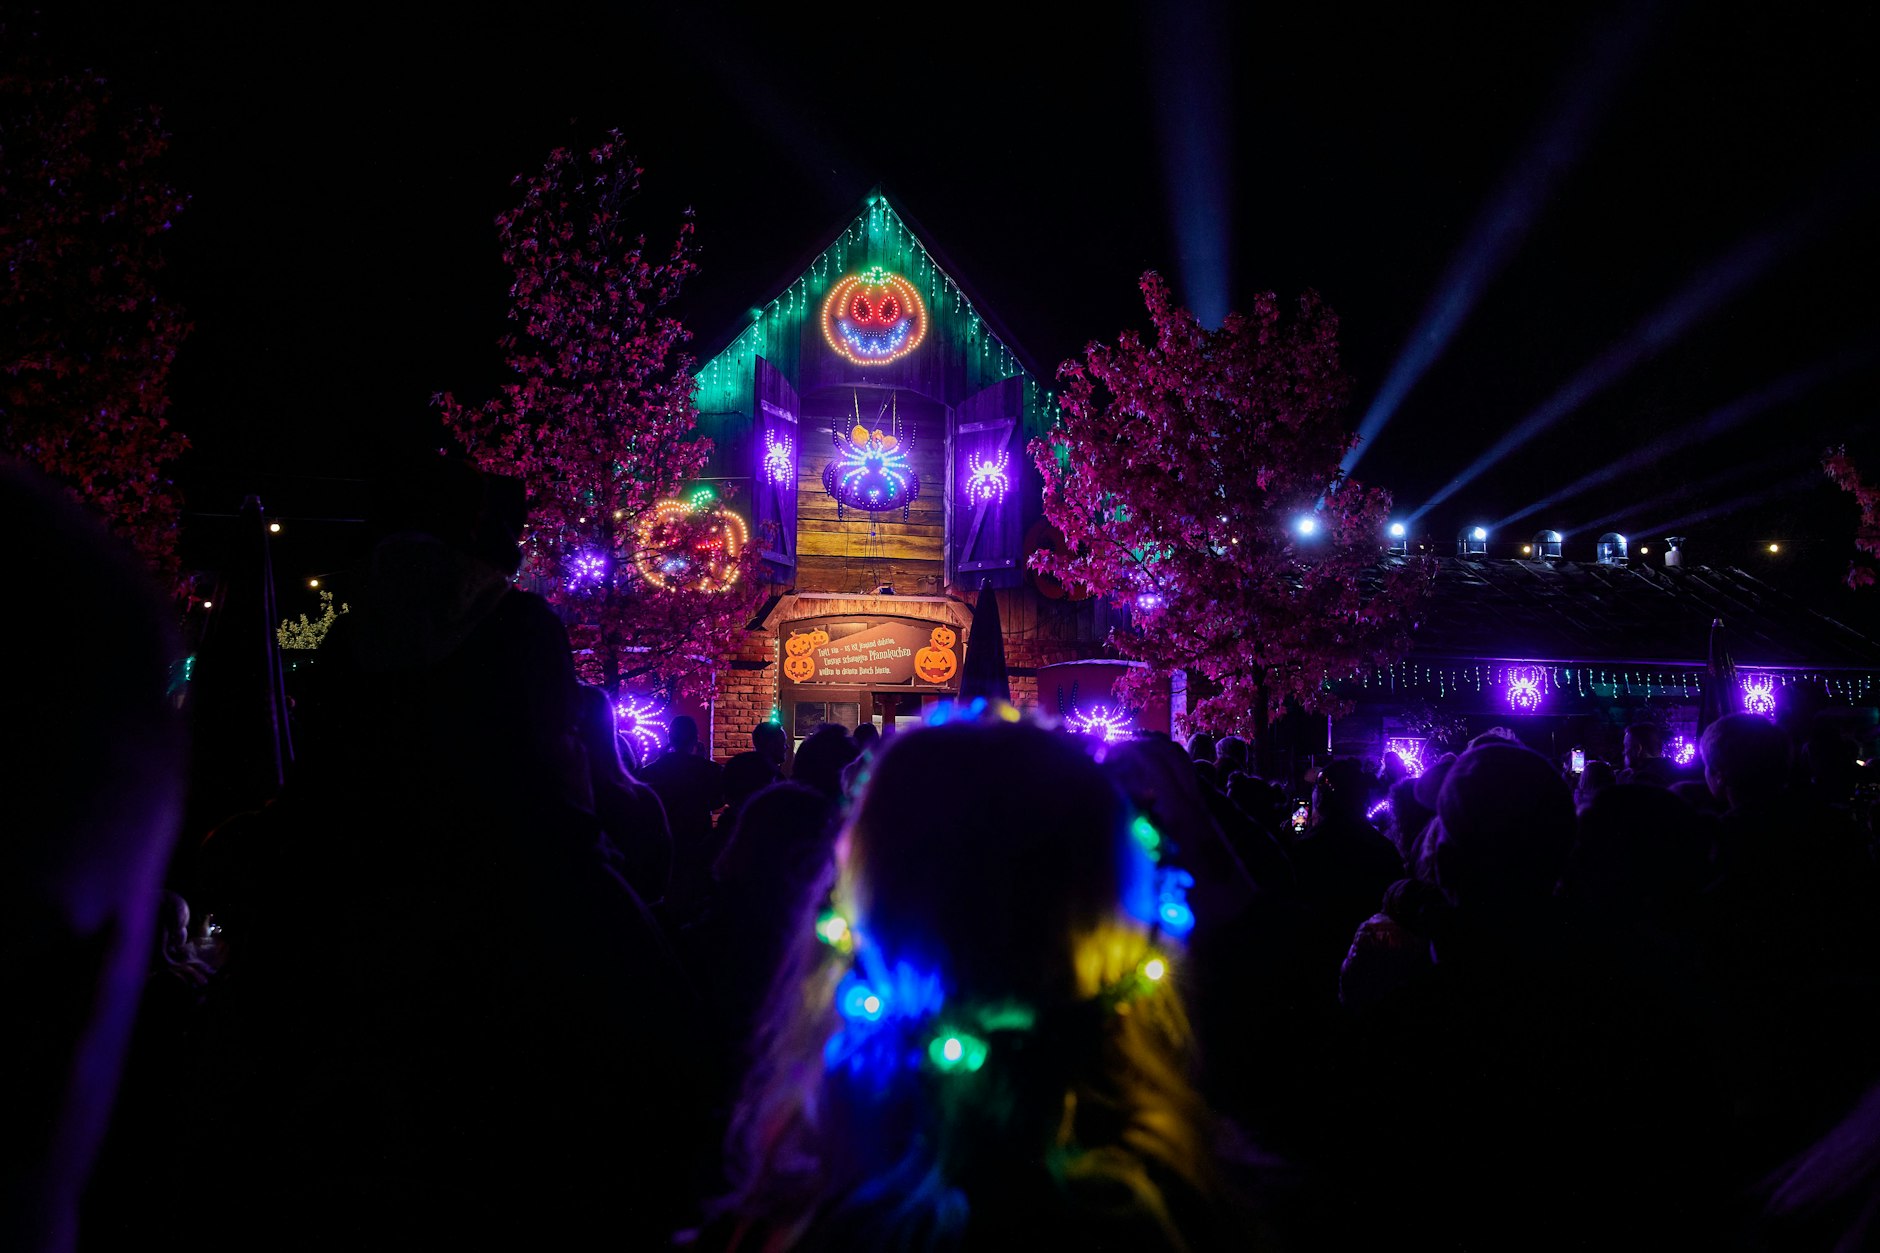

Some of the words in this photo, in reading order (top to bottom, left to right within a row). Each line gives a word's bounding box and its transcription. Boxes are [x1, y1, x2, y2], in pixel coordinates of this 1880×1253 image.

[869, 648, 911, 661] Pfannkuchen
[819, 668, 834, 676] wollen
[859, 666, 874, 676] Bauch
